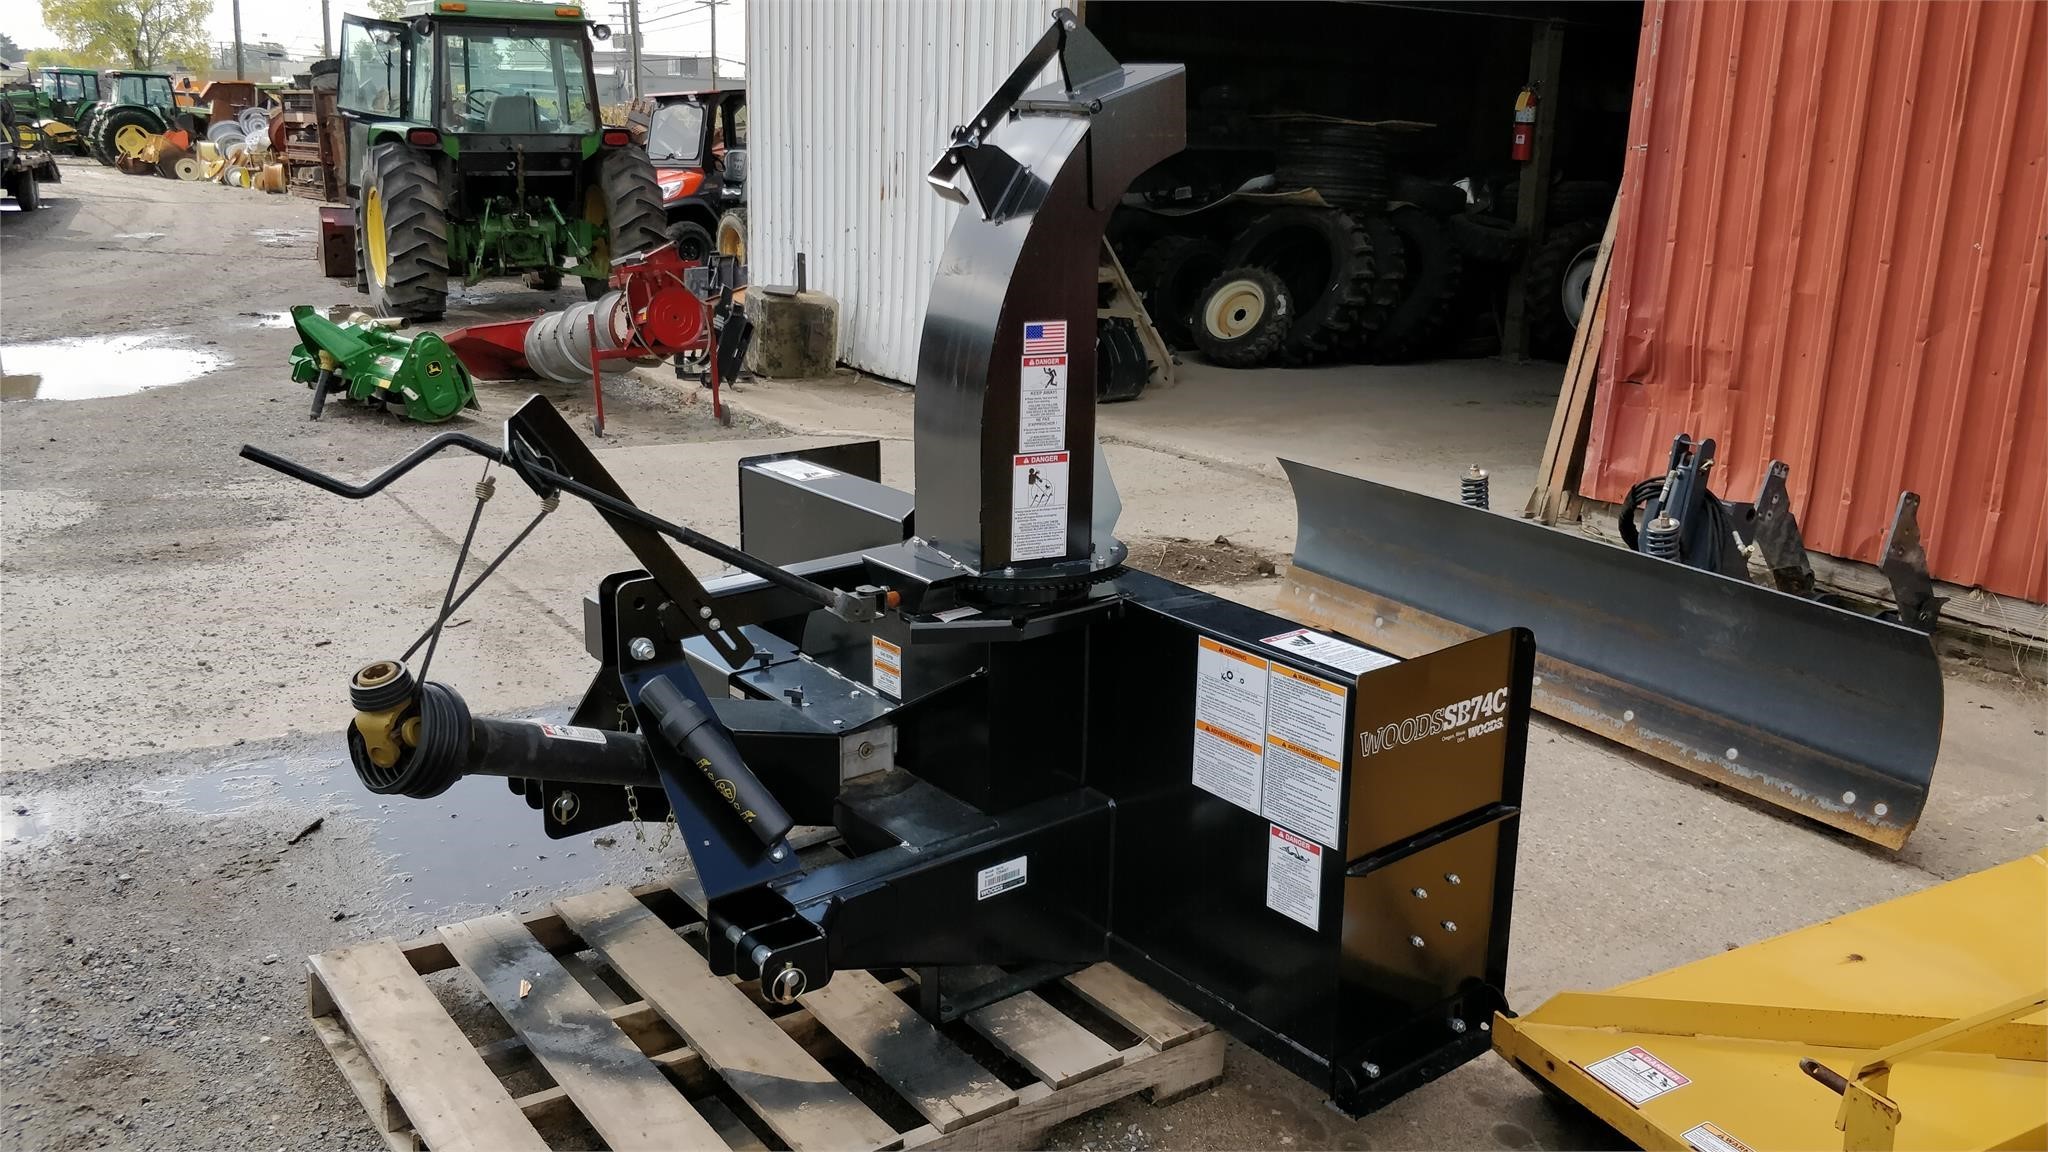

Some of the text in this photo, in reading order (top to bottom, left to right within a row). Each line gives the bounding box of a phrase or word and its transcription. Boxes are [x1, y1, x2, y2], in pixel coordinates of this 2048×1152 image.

[1035, 358, 1060, 366] DANGER
[1031, 455, 1059, 464] DANGER
[1224, 648, 1247, 661] WARNING
[1298, 675, 1321, 687] WARNING
[1359, 707, 1446, 757] WOODS
[1442, 686, 1509, 731] SB74C
[1285, 833, 1311, 851] DANGER
[1643, 1056, 1680, 1082] DANGER
